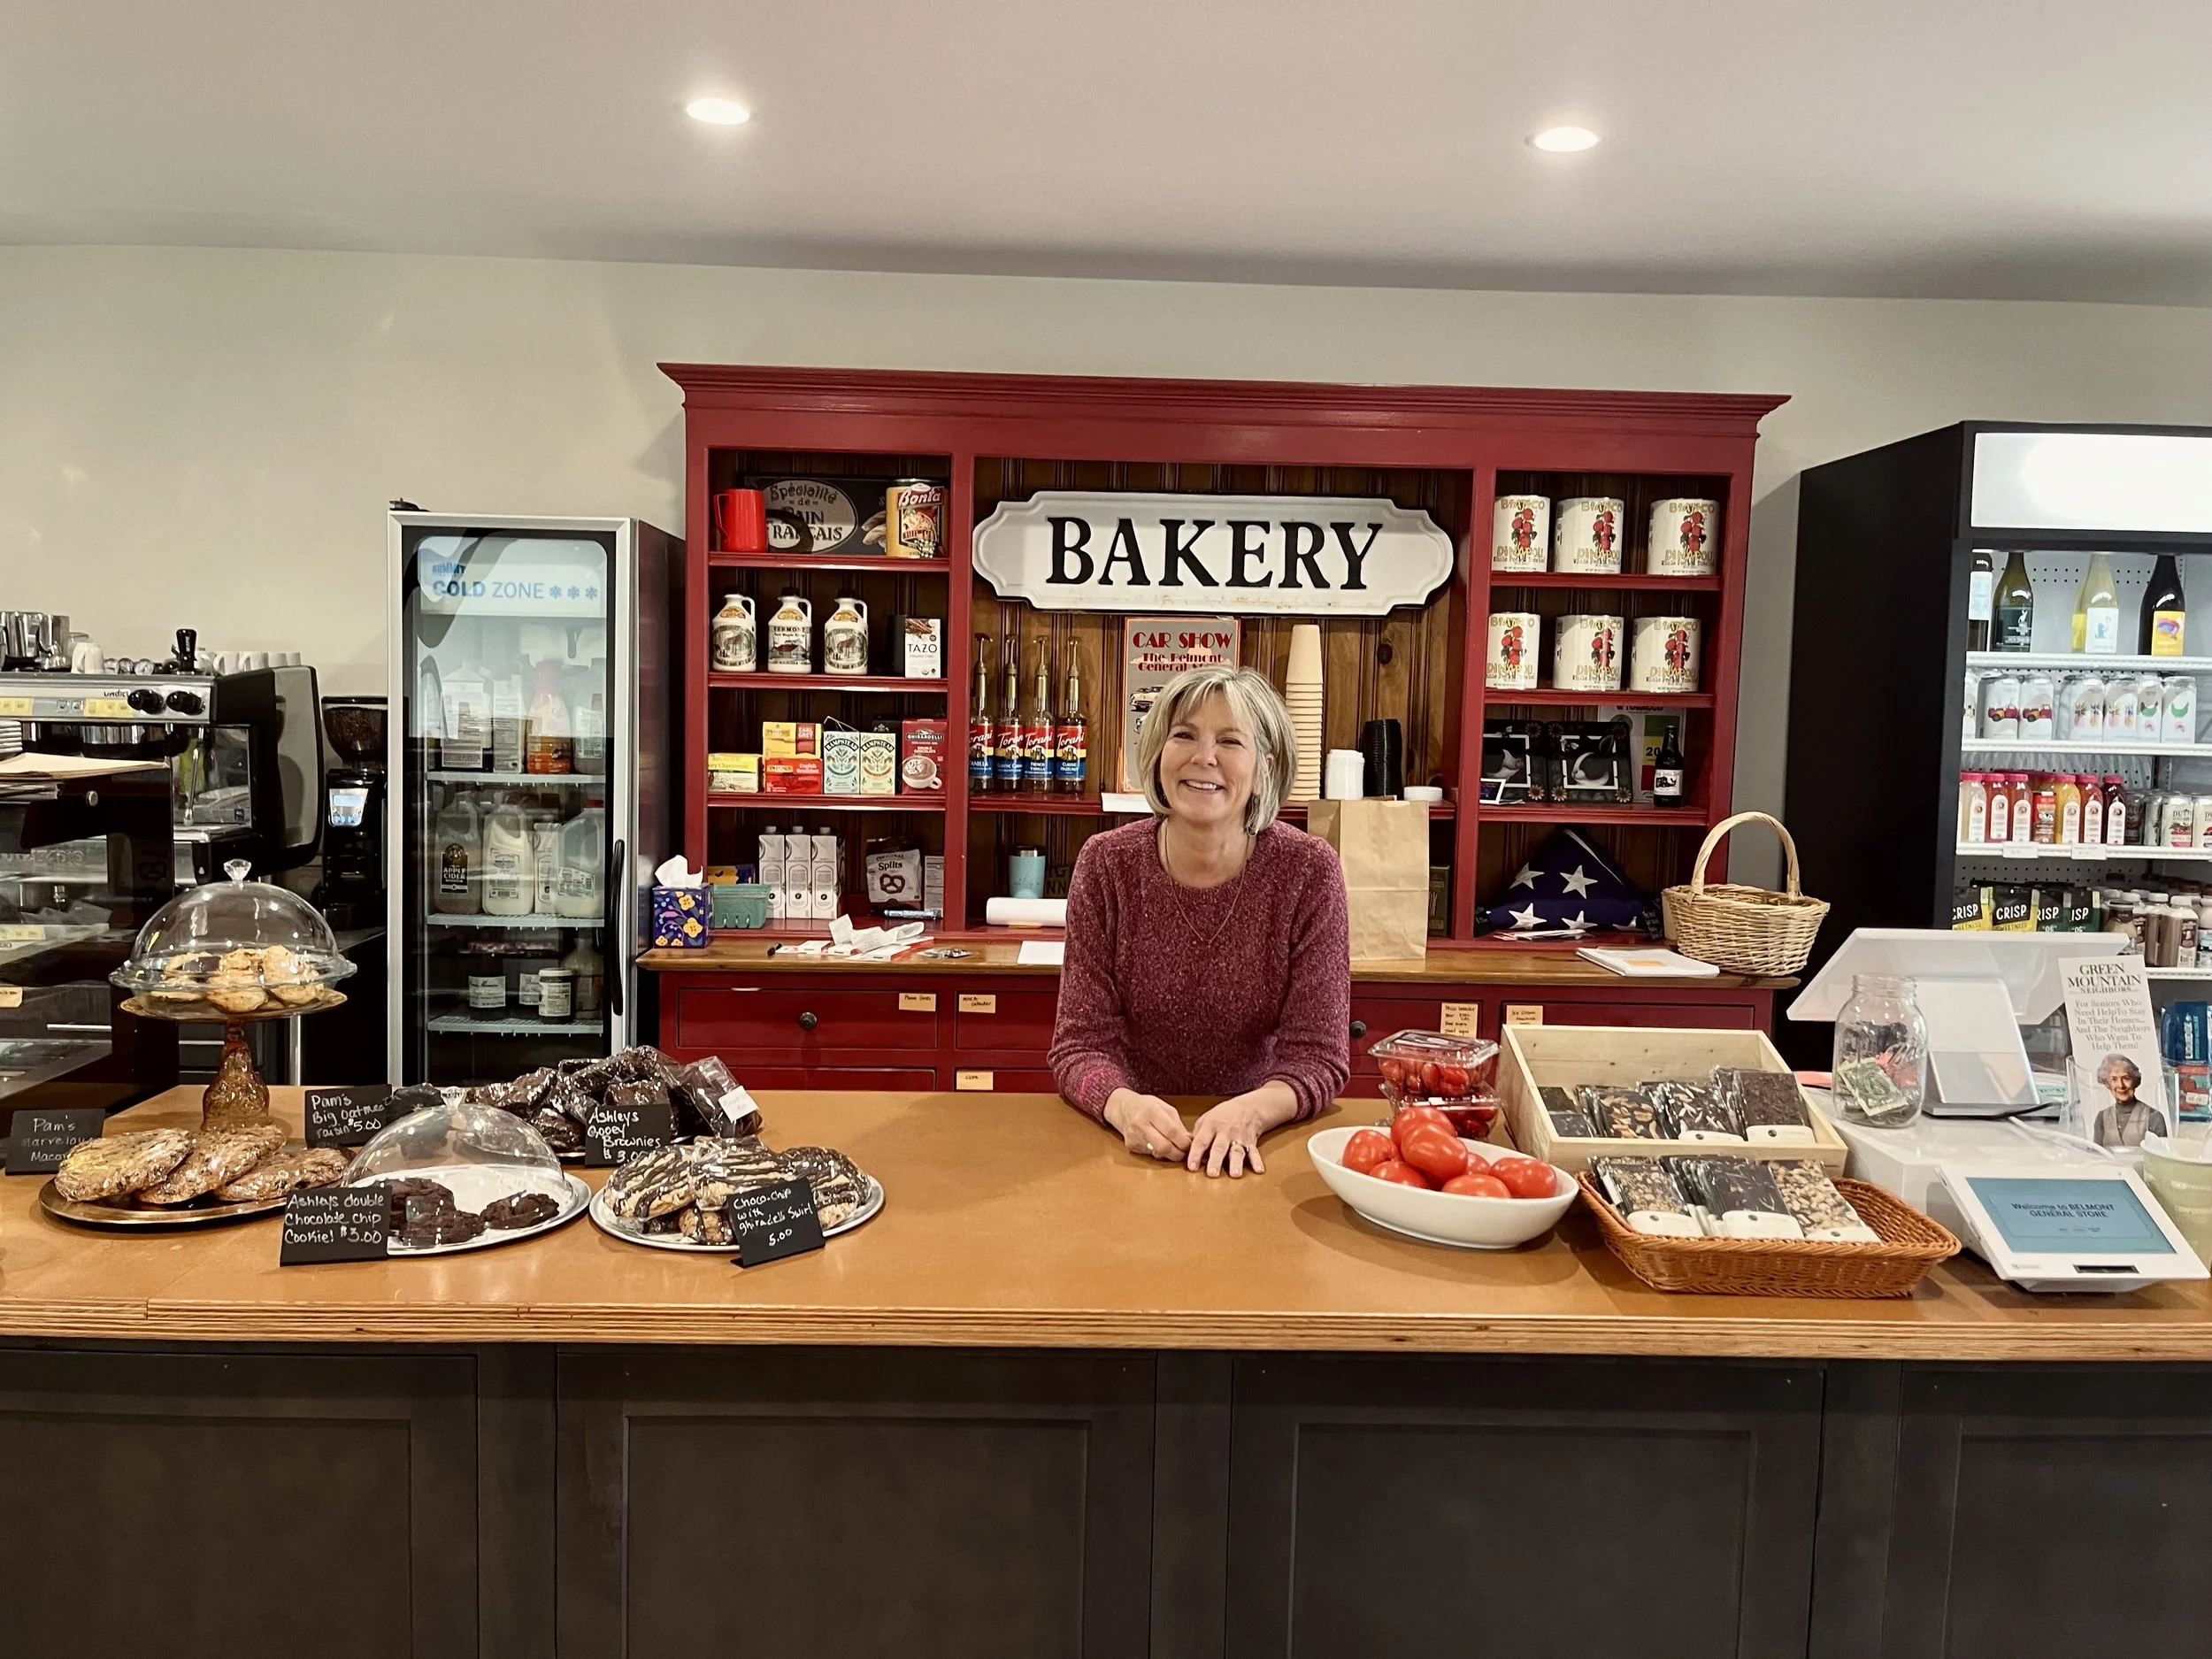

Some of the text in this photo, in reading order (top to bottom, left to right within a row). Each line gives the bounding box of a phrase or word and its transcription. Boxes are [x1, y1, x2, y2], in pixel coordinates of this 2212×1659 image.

[898, 488, 941, 507] Bonta
[782, 506, 824, 525] IN
[1046, 516, 1383, 590] BAKERY
[432, 580, 545, 599] COLD ZONE
[1133, 632, 1233, 649] CAR SHOW
[907, 643, 938, 653] TAZO
[1142, 653, 1222, 663] The Belmont
[1138, 663, 1187, 672] General
[969, 730, 993, 743] orani
[997, 732, 1024, 749] Toran
[1025, 731, 1053, 749] Torani
[1057, 732, 1085, 749] Torani
[878, 861, 902, 871] Splits
[1995, 904, 2027, 920] CRISP
[2037, 906, 2059, 920] RISP
[2070, 907, 2089, 921] ISP
[2079, 963, 2124, 975] GREEN
[2068, 974, 2141, 987] MOUNTAIN
[2097, 1008, 2117, 1017] Help
[2129, 1008, 2146, 1017] Stay
[2109, 1025, 2151, 1033] Neighbors
[2092, 1042, 2111, 1051] Help
[311, 1093, 352, 1110] Pam's
[34, 1115, 76, 1133] Pam's
[312, 1110, 338, 1127] Big
[587, 1124, 626, 1139] Gooey
[602, 1135, 661, 1148] Brownies
[30, 1151, 70, 1162] Macar
[343, 1194, 384, 1208] double
[284, 1211, 350, 1226] Chocolate
[737, 1207, 764, 1220] with
[284, 1225, 382, 1244] Cookie! $3.00
[769, 1228, 793, 1247] 5.00
